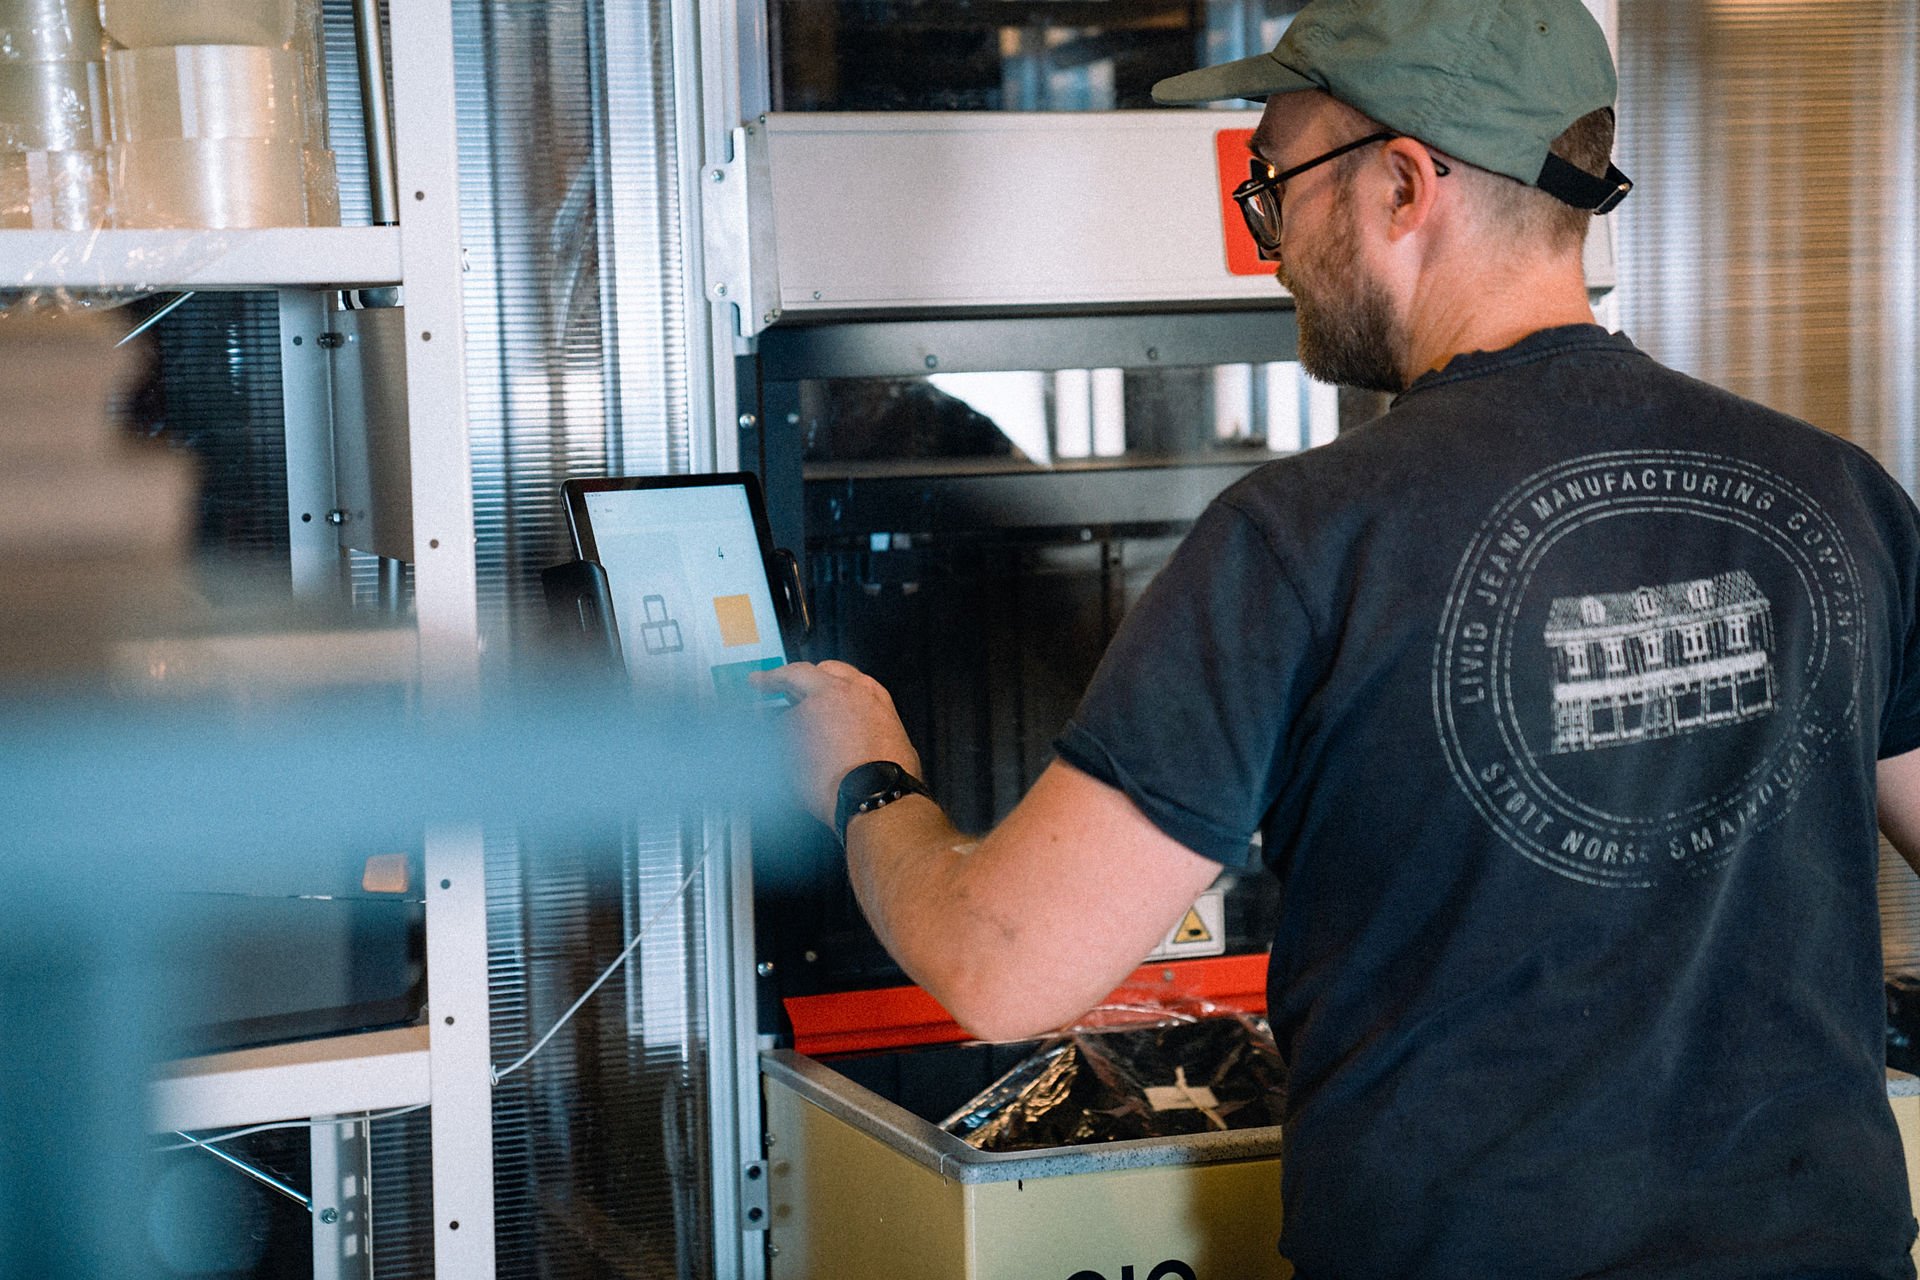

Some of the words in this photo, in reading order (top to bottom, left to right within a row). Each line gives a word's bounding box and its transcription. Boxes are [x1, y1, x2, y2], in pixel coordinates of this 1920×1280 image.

[1459, 621, 1488, 705] LIVID
[1475, 522, 1531, 606] JEANS
[1531, 468, 1776, 519] MANUFACTURING
[1786, 511, 1853, 645] COMPANY
